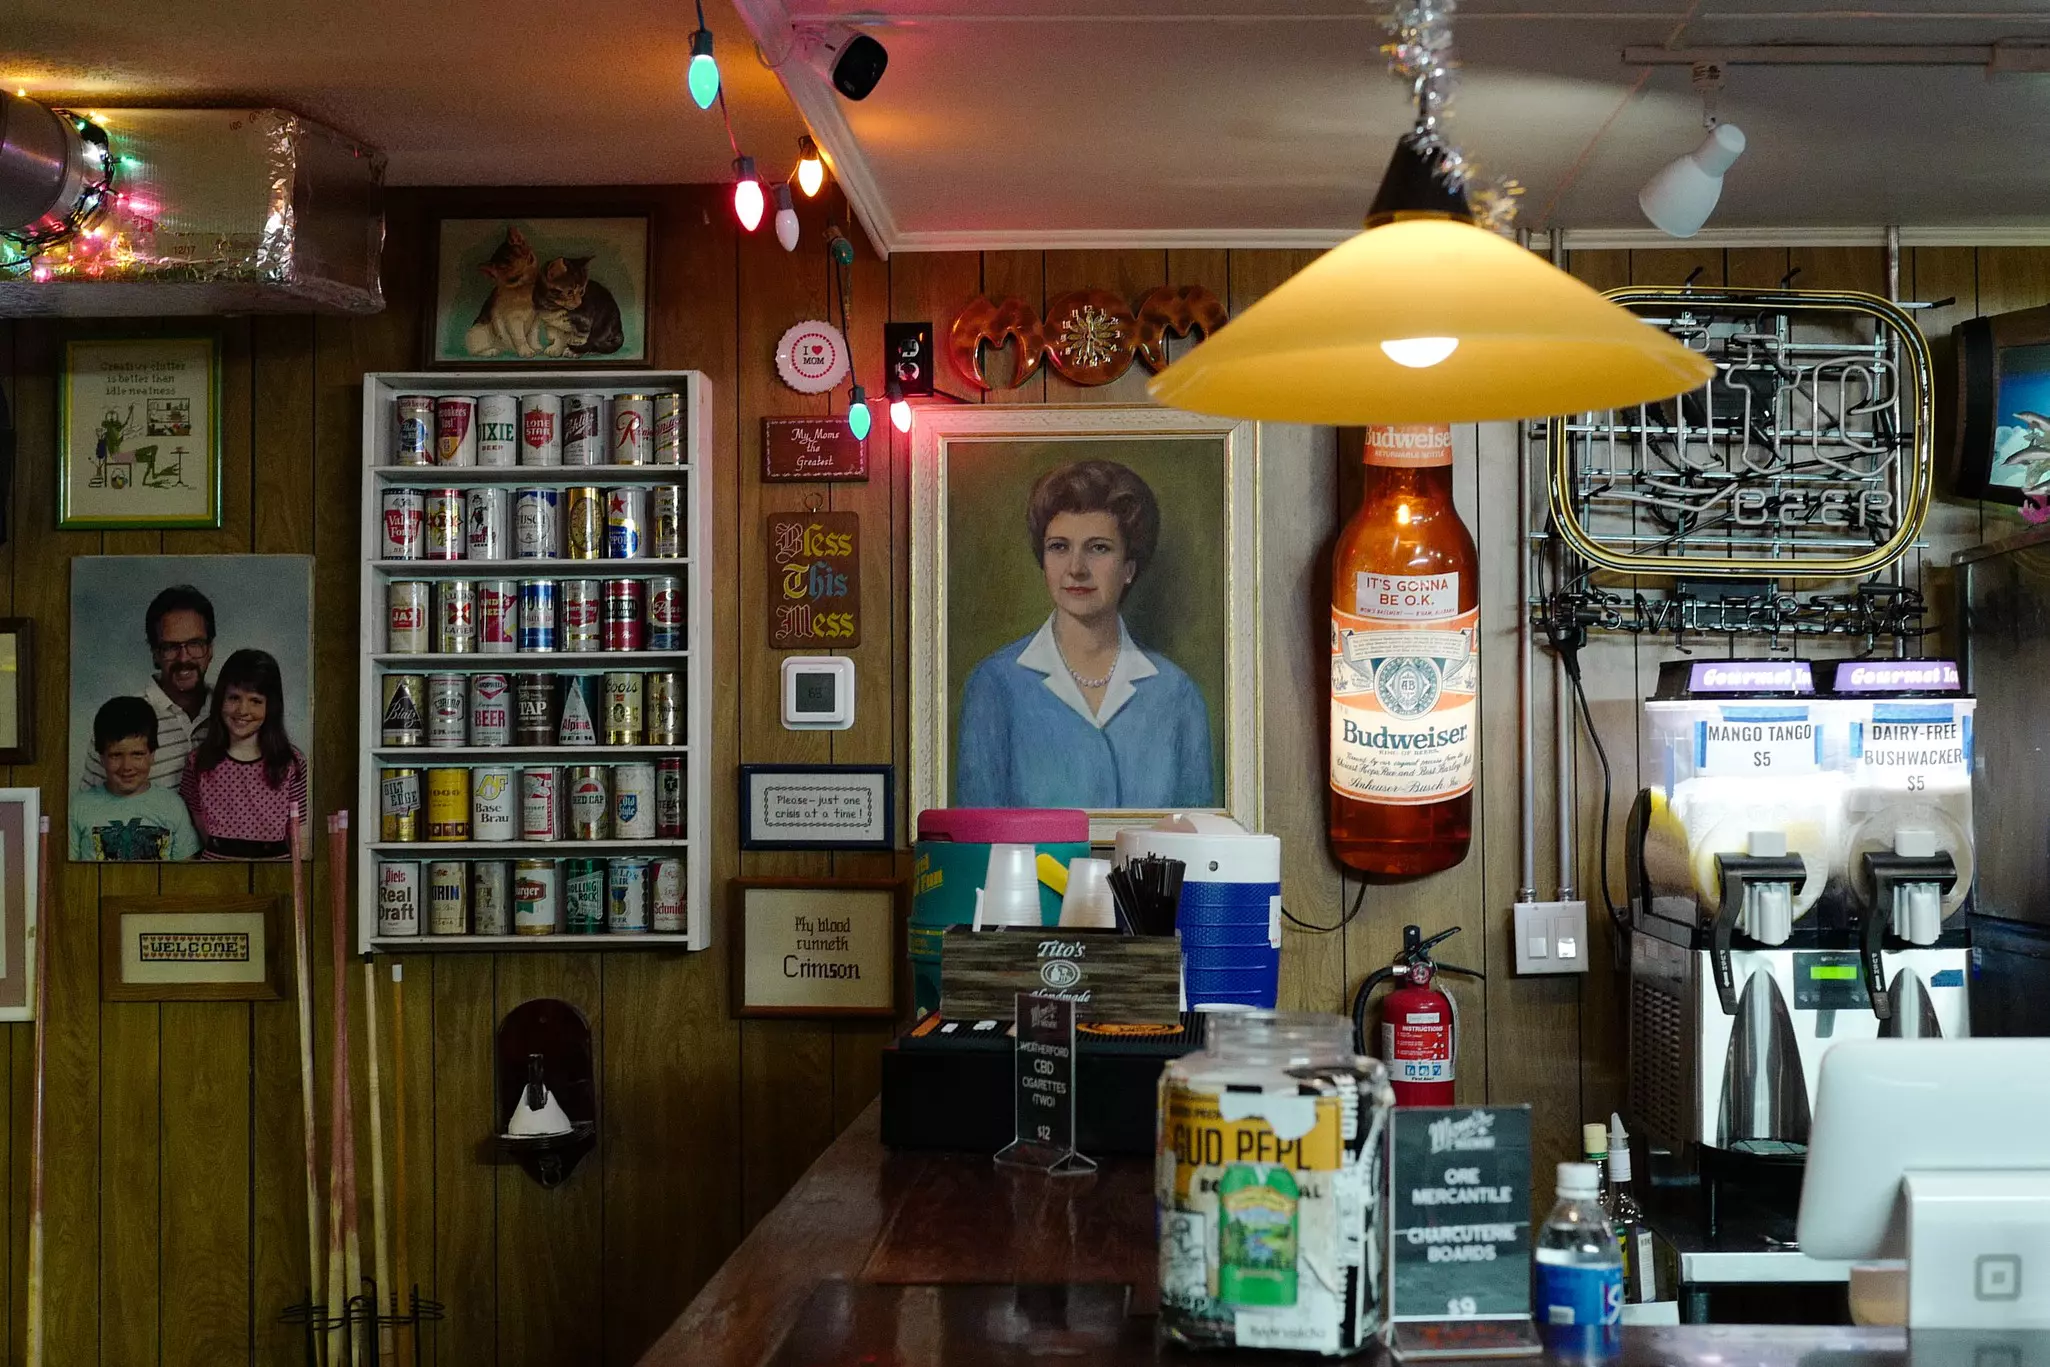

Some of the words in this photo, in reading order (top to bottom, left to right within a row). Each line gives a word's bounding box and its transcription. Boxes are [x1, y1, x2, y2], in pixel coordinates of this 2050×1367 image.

[803, 357, 825, 365] MOM
[107, 375, 116, 383] is
[118, 374, 149, 383] better
[152, 374, 175, 383] than
[106, 386, 127, 395] idle
[129, 386, 176, 395] neatness
[526, 419, 550, 428] LONE
[526, 428, 550, 436] STAR
[791, 427, 810, 444] My
[809, 427, 840, 440] Moms
[806, 441, 821, 453] the
[796, 455, 834, 472] Greatest
[775, 522, 853, 564] Bless
[782, 560, 848, 602] This
[1366, 577, 1391, 591] IT'S
[1397, 578, 1448, 591] GONNA
[1379, 594, 1399, 606] BE
[392, 610, 418, 622] JAX
[775, 604, 855, 640] Mess
[1703, 667, 1793, 685] Gourmet
[1850, 666, 1940, 685] Gourmet
[605, 678, 638, 693] Coors
[385, 696, 421, 728] Blatz
[518, 701, 547, 715] TAP
[475, 709, 506, 727] BEER
[562, 718, 591, 731] Alpine
[1342, 718, 1467, 749] Budweiser
[1708, 725, 1762, 742] MANGO
[1767, 724, 1812, 741] TANGO
[1873, 723, 1957, 741] DAIRY-FREE
[1753, 750, 1772, 767] $5
[1864, 748, 1962, 765] BUSHWACKER
[1907, 775, 1925, 791] $5
[391, 791, 418, 807] EDGE
[588, 795, 604, 804] CAP
[622, 796, 635, 805] Old
[817, 795, 839, 807] just
[843, 797, 861, 806] one
[476, 803, 502, 812] Base
[775, 809, 800, 819] crisis
[804, 809, 817, 819] at
[822, 811, 829, 819] a
[481, 813, 509, 823] Brau
[379, 886, 411, 902] Real
[578, 891, 598, 902] ROCK
[379, 903, 415, 921] Draft
[795, 916, 814, 934] My
[817, 916, 851, 933] blood
[150, 942, 239, 953] WELCOME
[796, 936, 849, 951] runneth
[1037, 940, 1086, 957] Tito's
[783, 954, 861, 980] Crimson
[1033, 1059, 1054, 1075] CBD
[1022, 1076, 1067, 1094] CIGARETTES
[1032, 1093, 1056, 1107] (TWO)
[1037, 1126, 1051, 1141] $12
[1411, 1186, 1513, 1206] MERCANTILE
[1427, 1244, 1497, 1263] BOARDS
